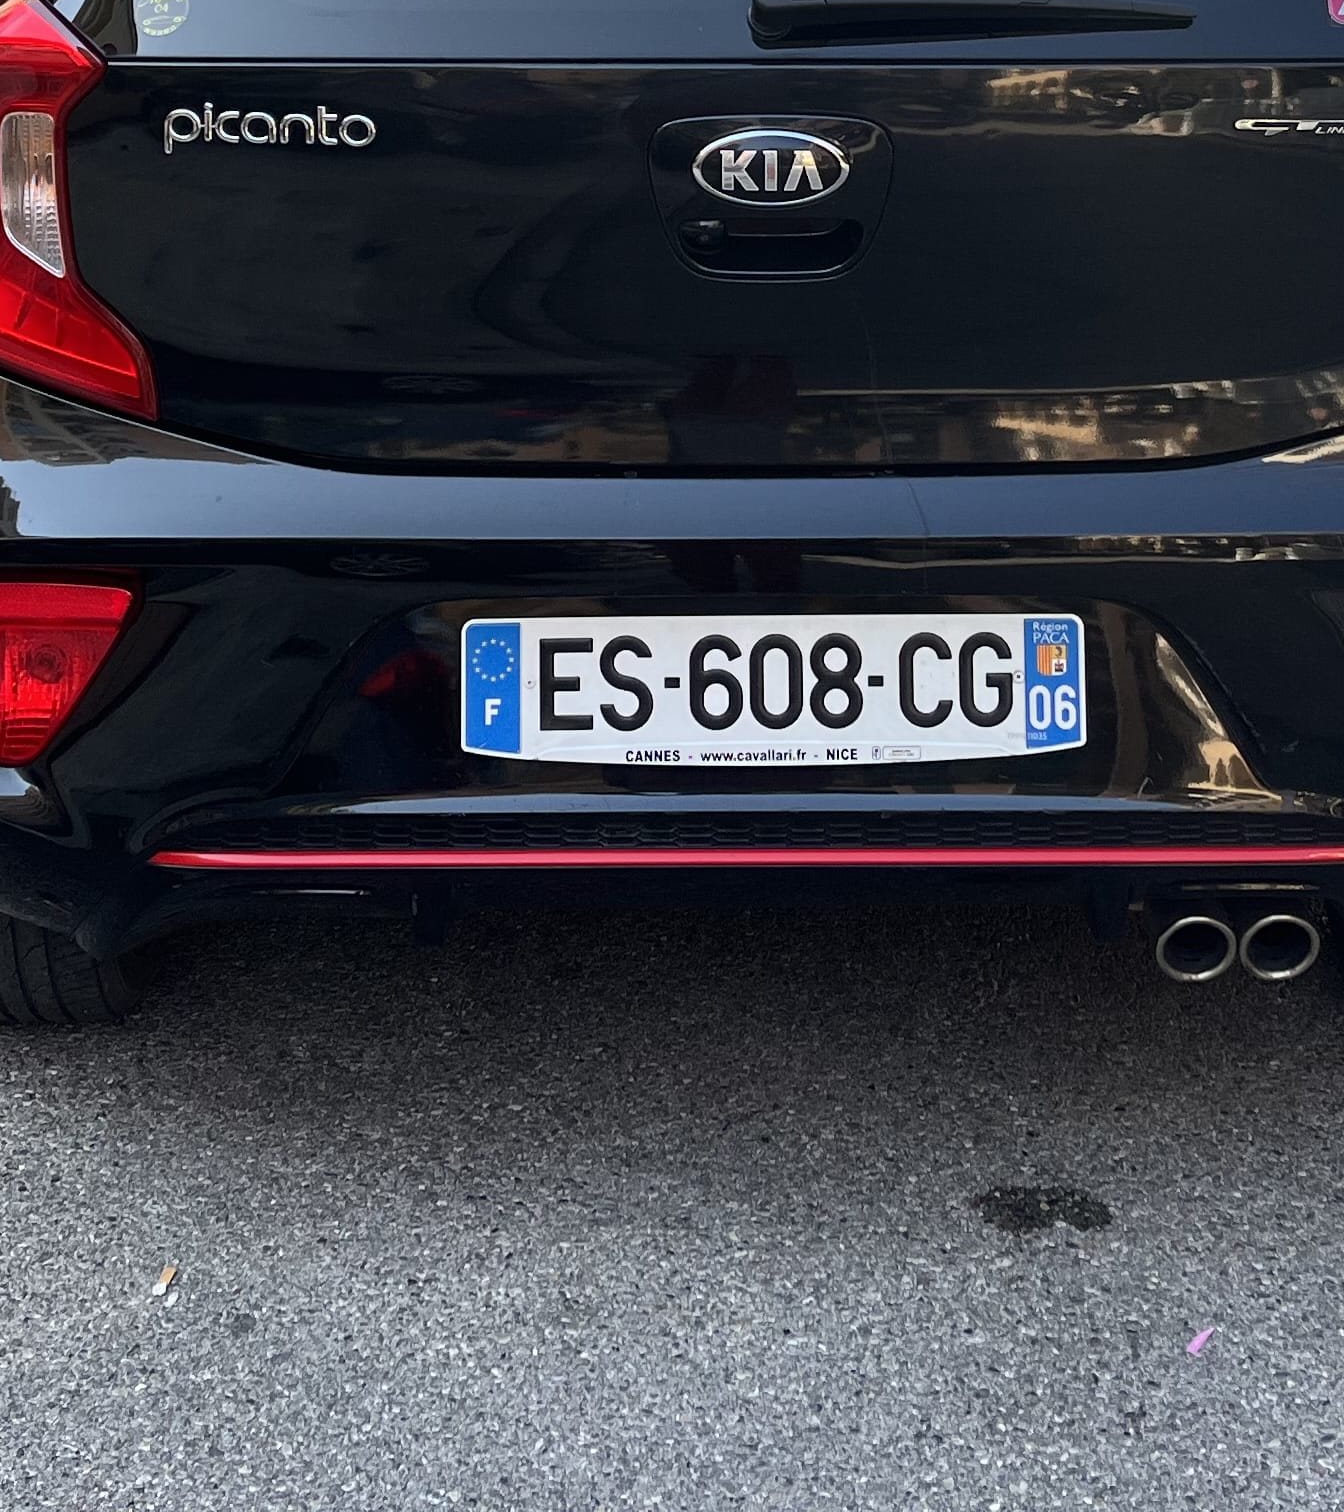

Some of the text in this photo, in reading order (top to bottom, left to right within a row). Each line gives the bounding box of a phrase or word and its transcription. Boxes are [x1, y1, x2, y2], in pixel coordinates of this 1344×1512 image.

[164, 102, 377, 155] picanto
[719, 149, 824, 192] KIA
[1032, 621, 1069, 633] Région
[1032, 631, 1070, 644] PACA
[539, 631, 1014, 732] ES-608-CG
[484, 698, 502, 726] F
[1028, 684, 1077, 731] 06
[625, 748, 858, 762] CANNES www.cavallari.fr NICE
